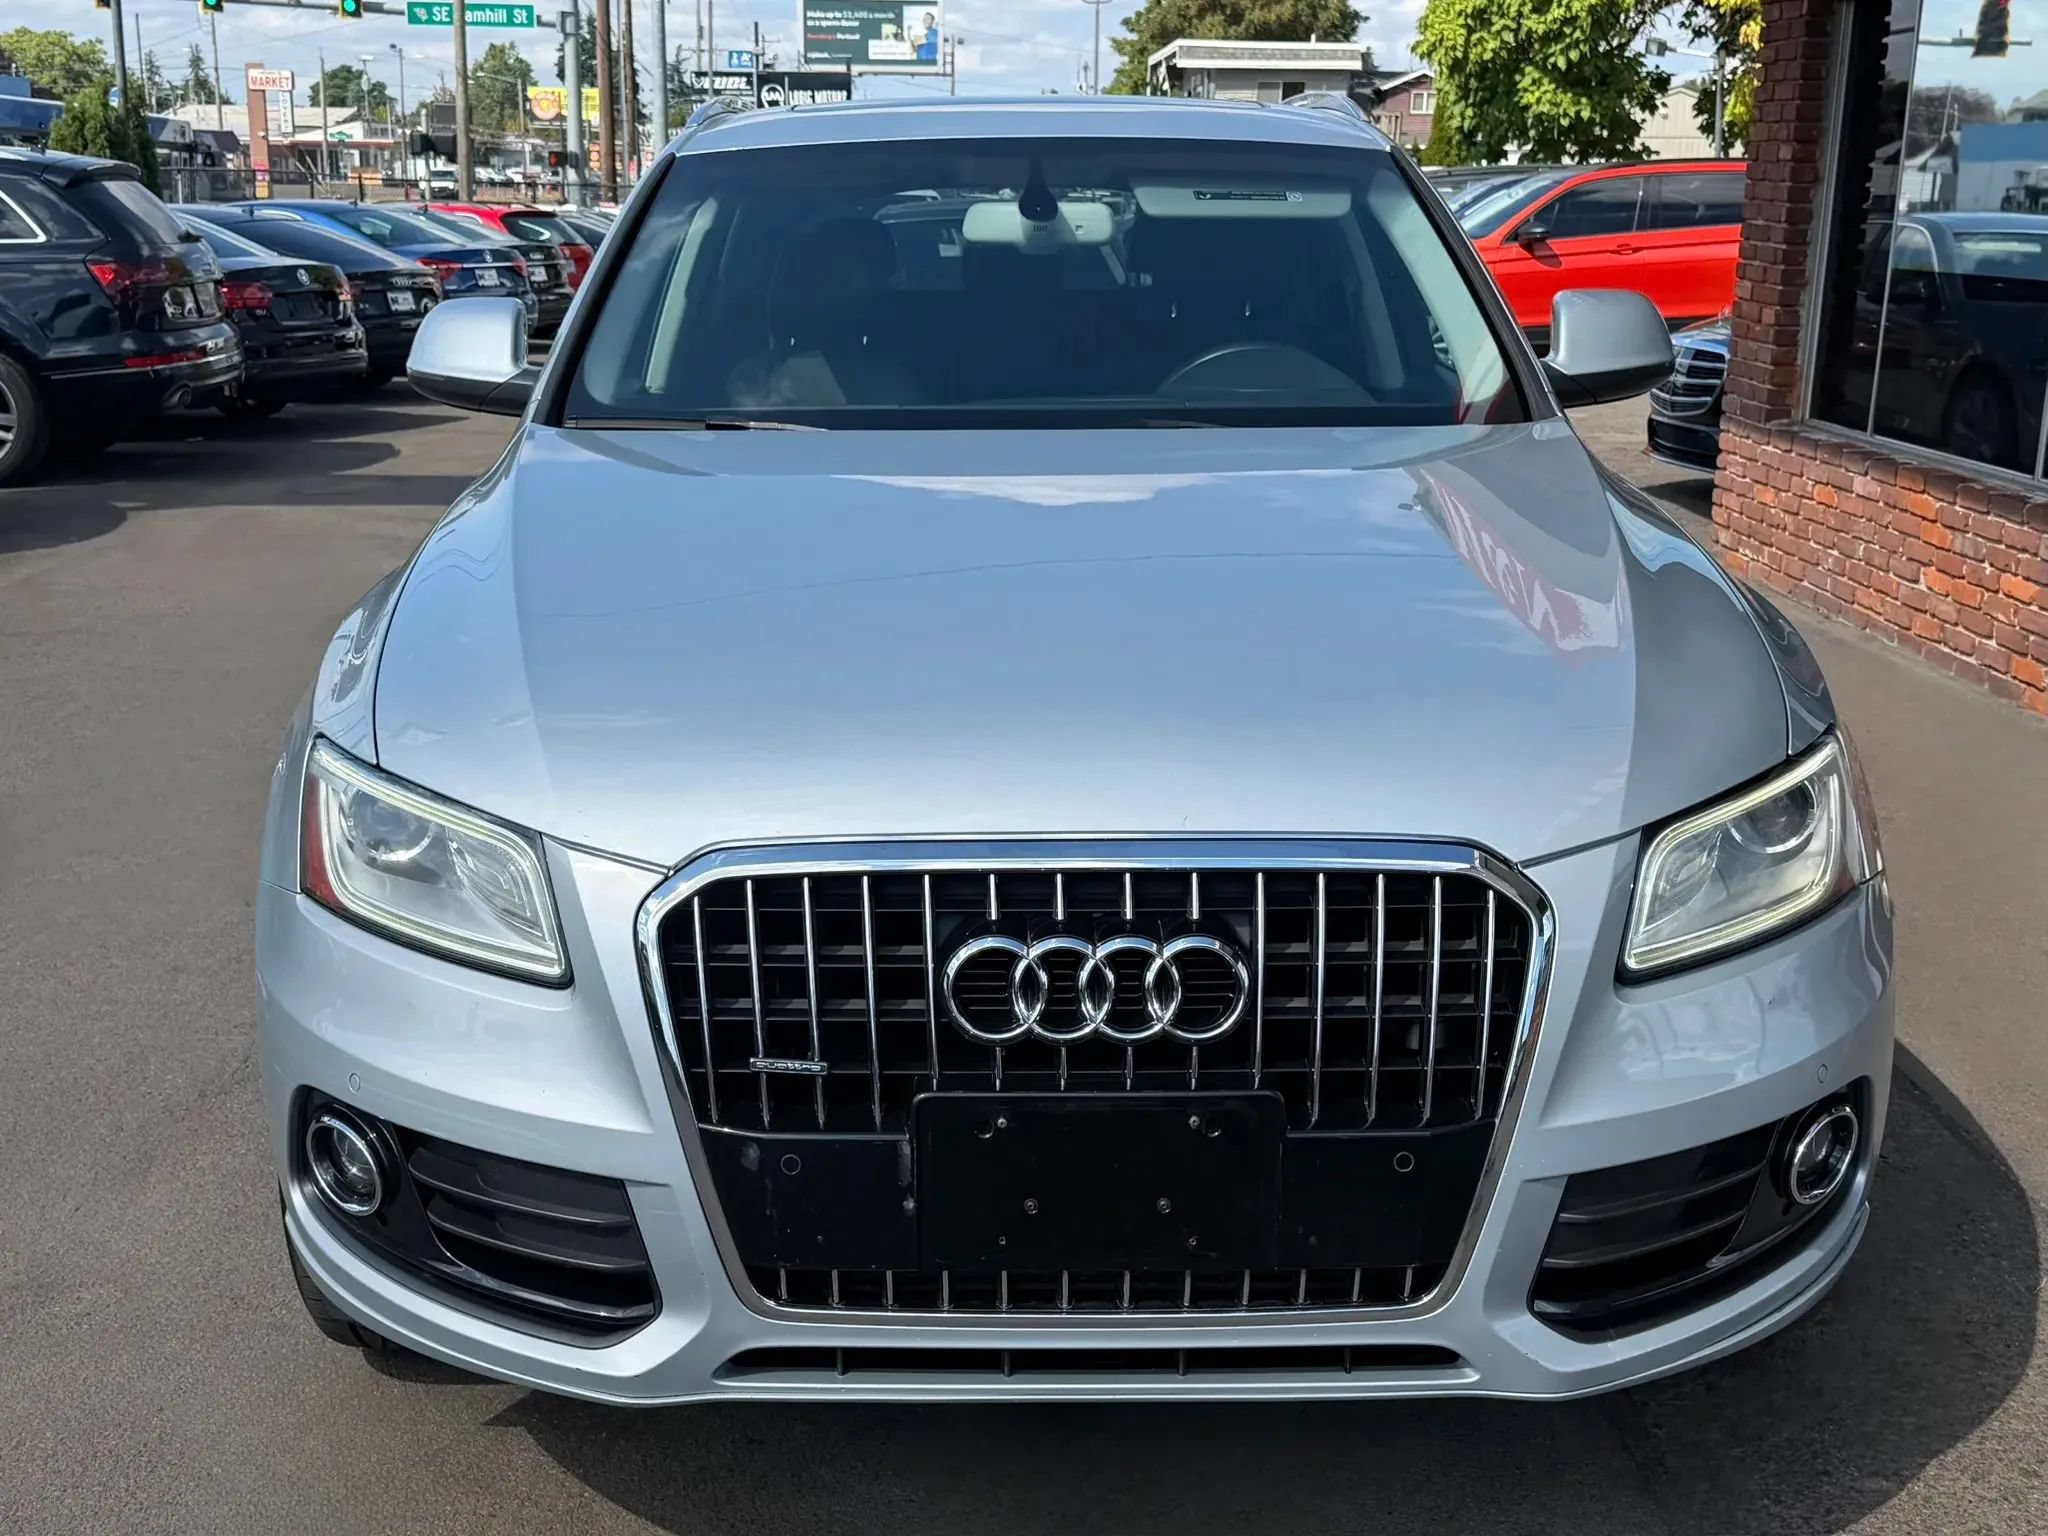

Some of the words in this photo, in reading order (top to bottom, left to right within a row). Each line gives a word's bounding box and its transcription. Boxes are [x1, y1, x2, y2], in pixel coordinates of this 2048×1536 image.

[432, 6, 451, 22] SE
[464, 7, 508, 24] amhill
[512, 8, 529, 24] St
[250, 75, 290, 88] MARKET
[755, 1061, 822, 1072] quattro
